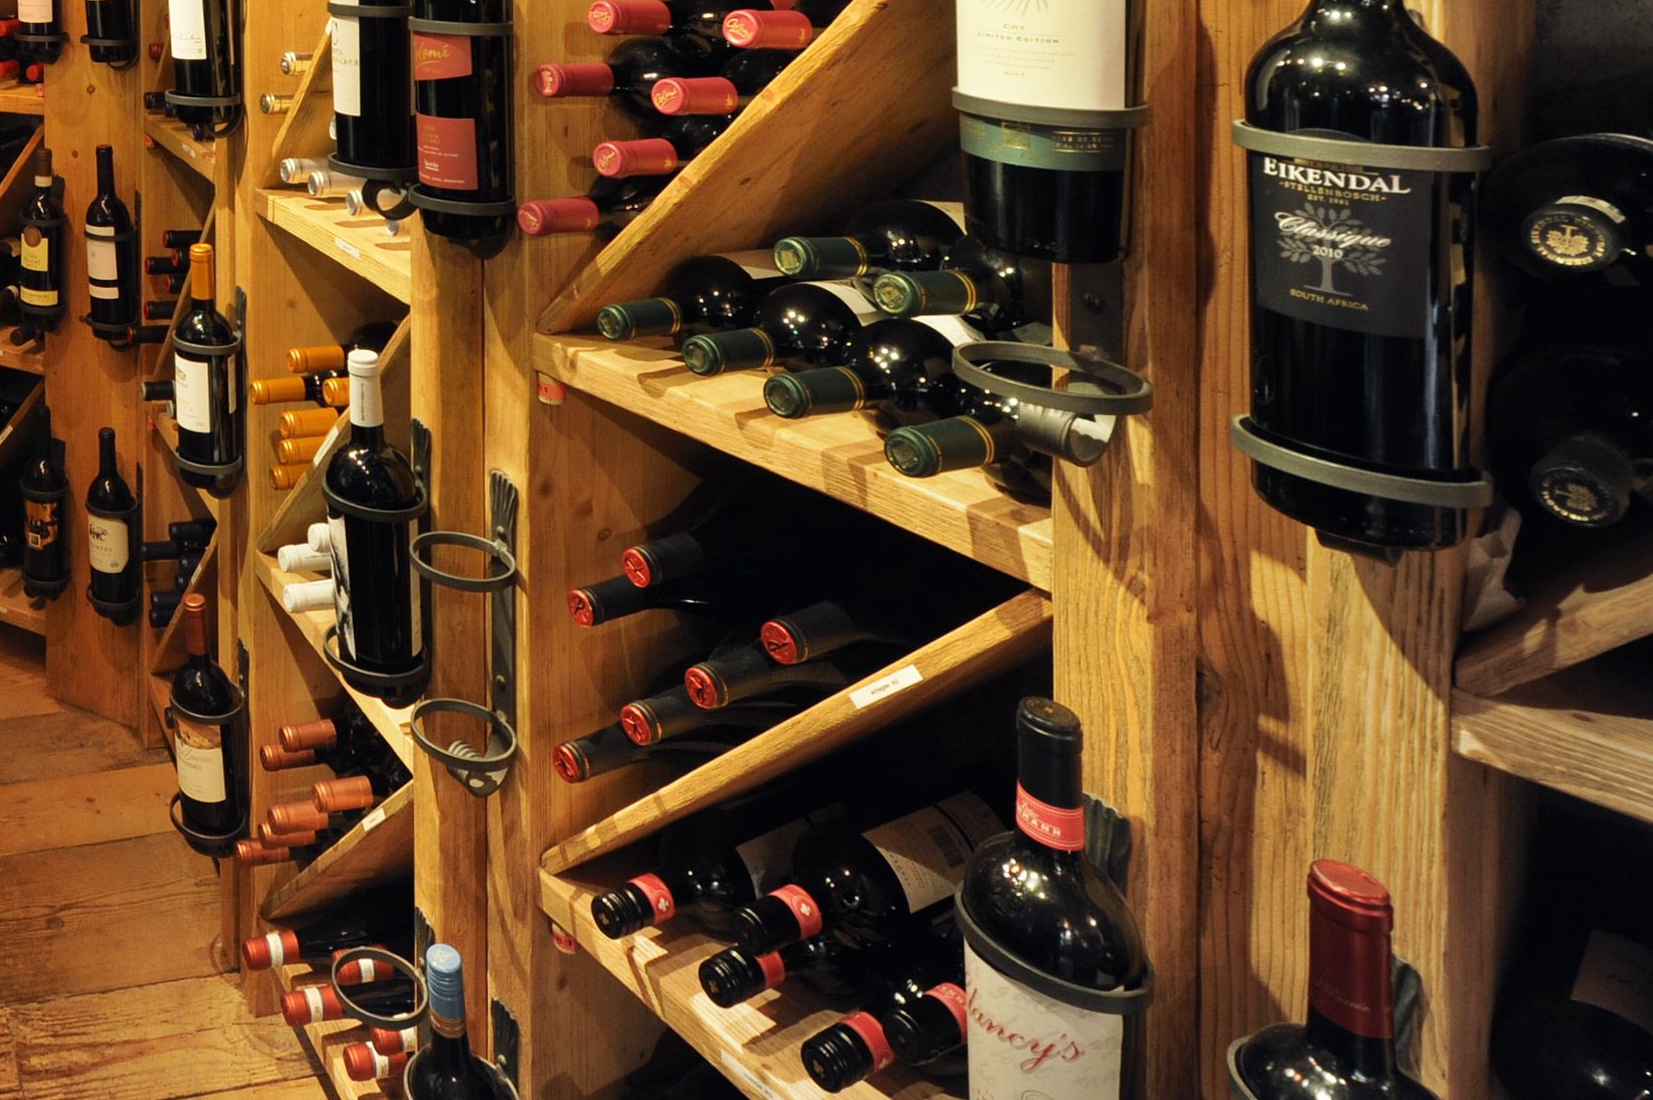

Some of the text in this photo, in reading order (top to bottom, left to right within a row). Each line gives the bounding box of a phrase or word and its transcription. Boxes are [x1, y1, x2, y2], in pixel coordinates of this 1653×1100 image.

[1016, 35, 1060, 44] EDITION
[1263, 156, 1412, 195] EIKENDAL
[1274, 211, 1392, 249] Classique
[1312, 244, 1344, 259] 2010
[1290, 288, 1369, 312] SOUTH AFRICA
[966, 985, 1086, 1076] lancy's
